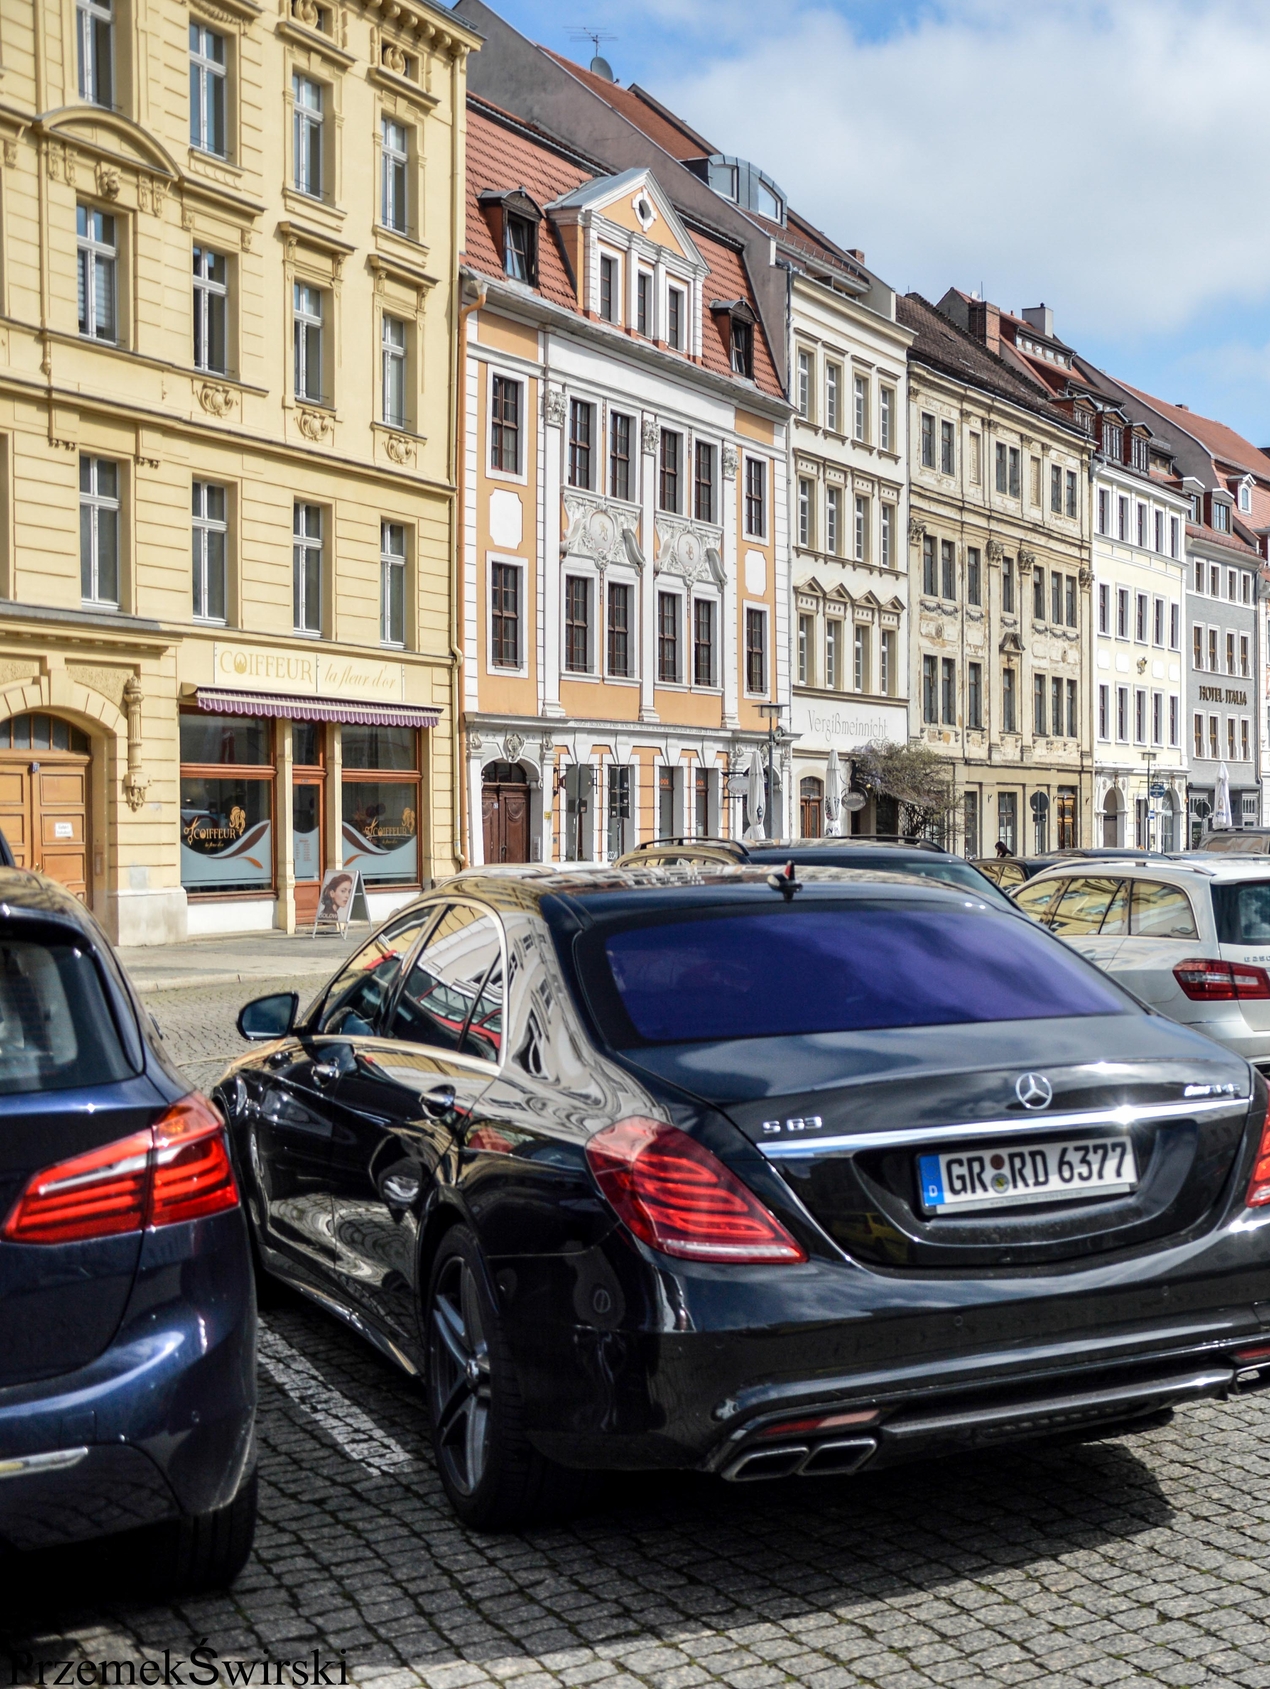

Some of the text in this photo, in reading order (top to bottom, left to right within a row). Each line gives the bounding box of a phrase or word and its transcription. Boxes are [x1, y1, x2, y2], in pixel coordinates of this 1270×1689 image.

[220, 650, 396, 691] COIFFEUR la fleur d'or
[1199, 685, 1248, 707] HOTEL ITALIA
[807, 709, 889, 742] Vergißmeinnicht
[193, 827, 237, 840] COIFFEUR
[373, 826, 407, 837] COIFFEUR
[762, 1115, 823, 1135] S 63
[945, 1156, 989, 1196] GR
[1007, 1149, 1049, 1190] RD
[1057, 1141, 1128, 1184] 6377
